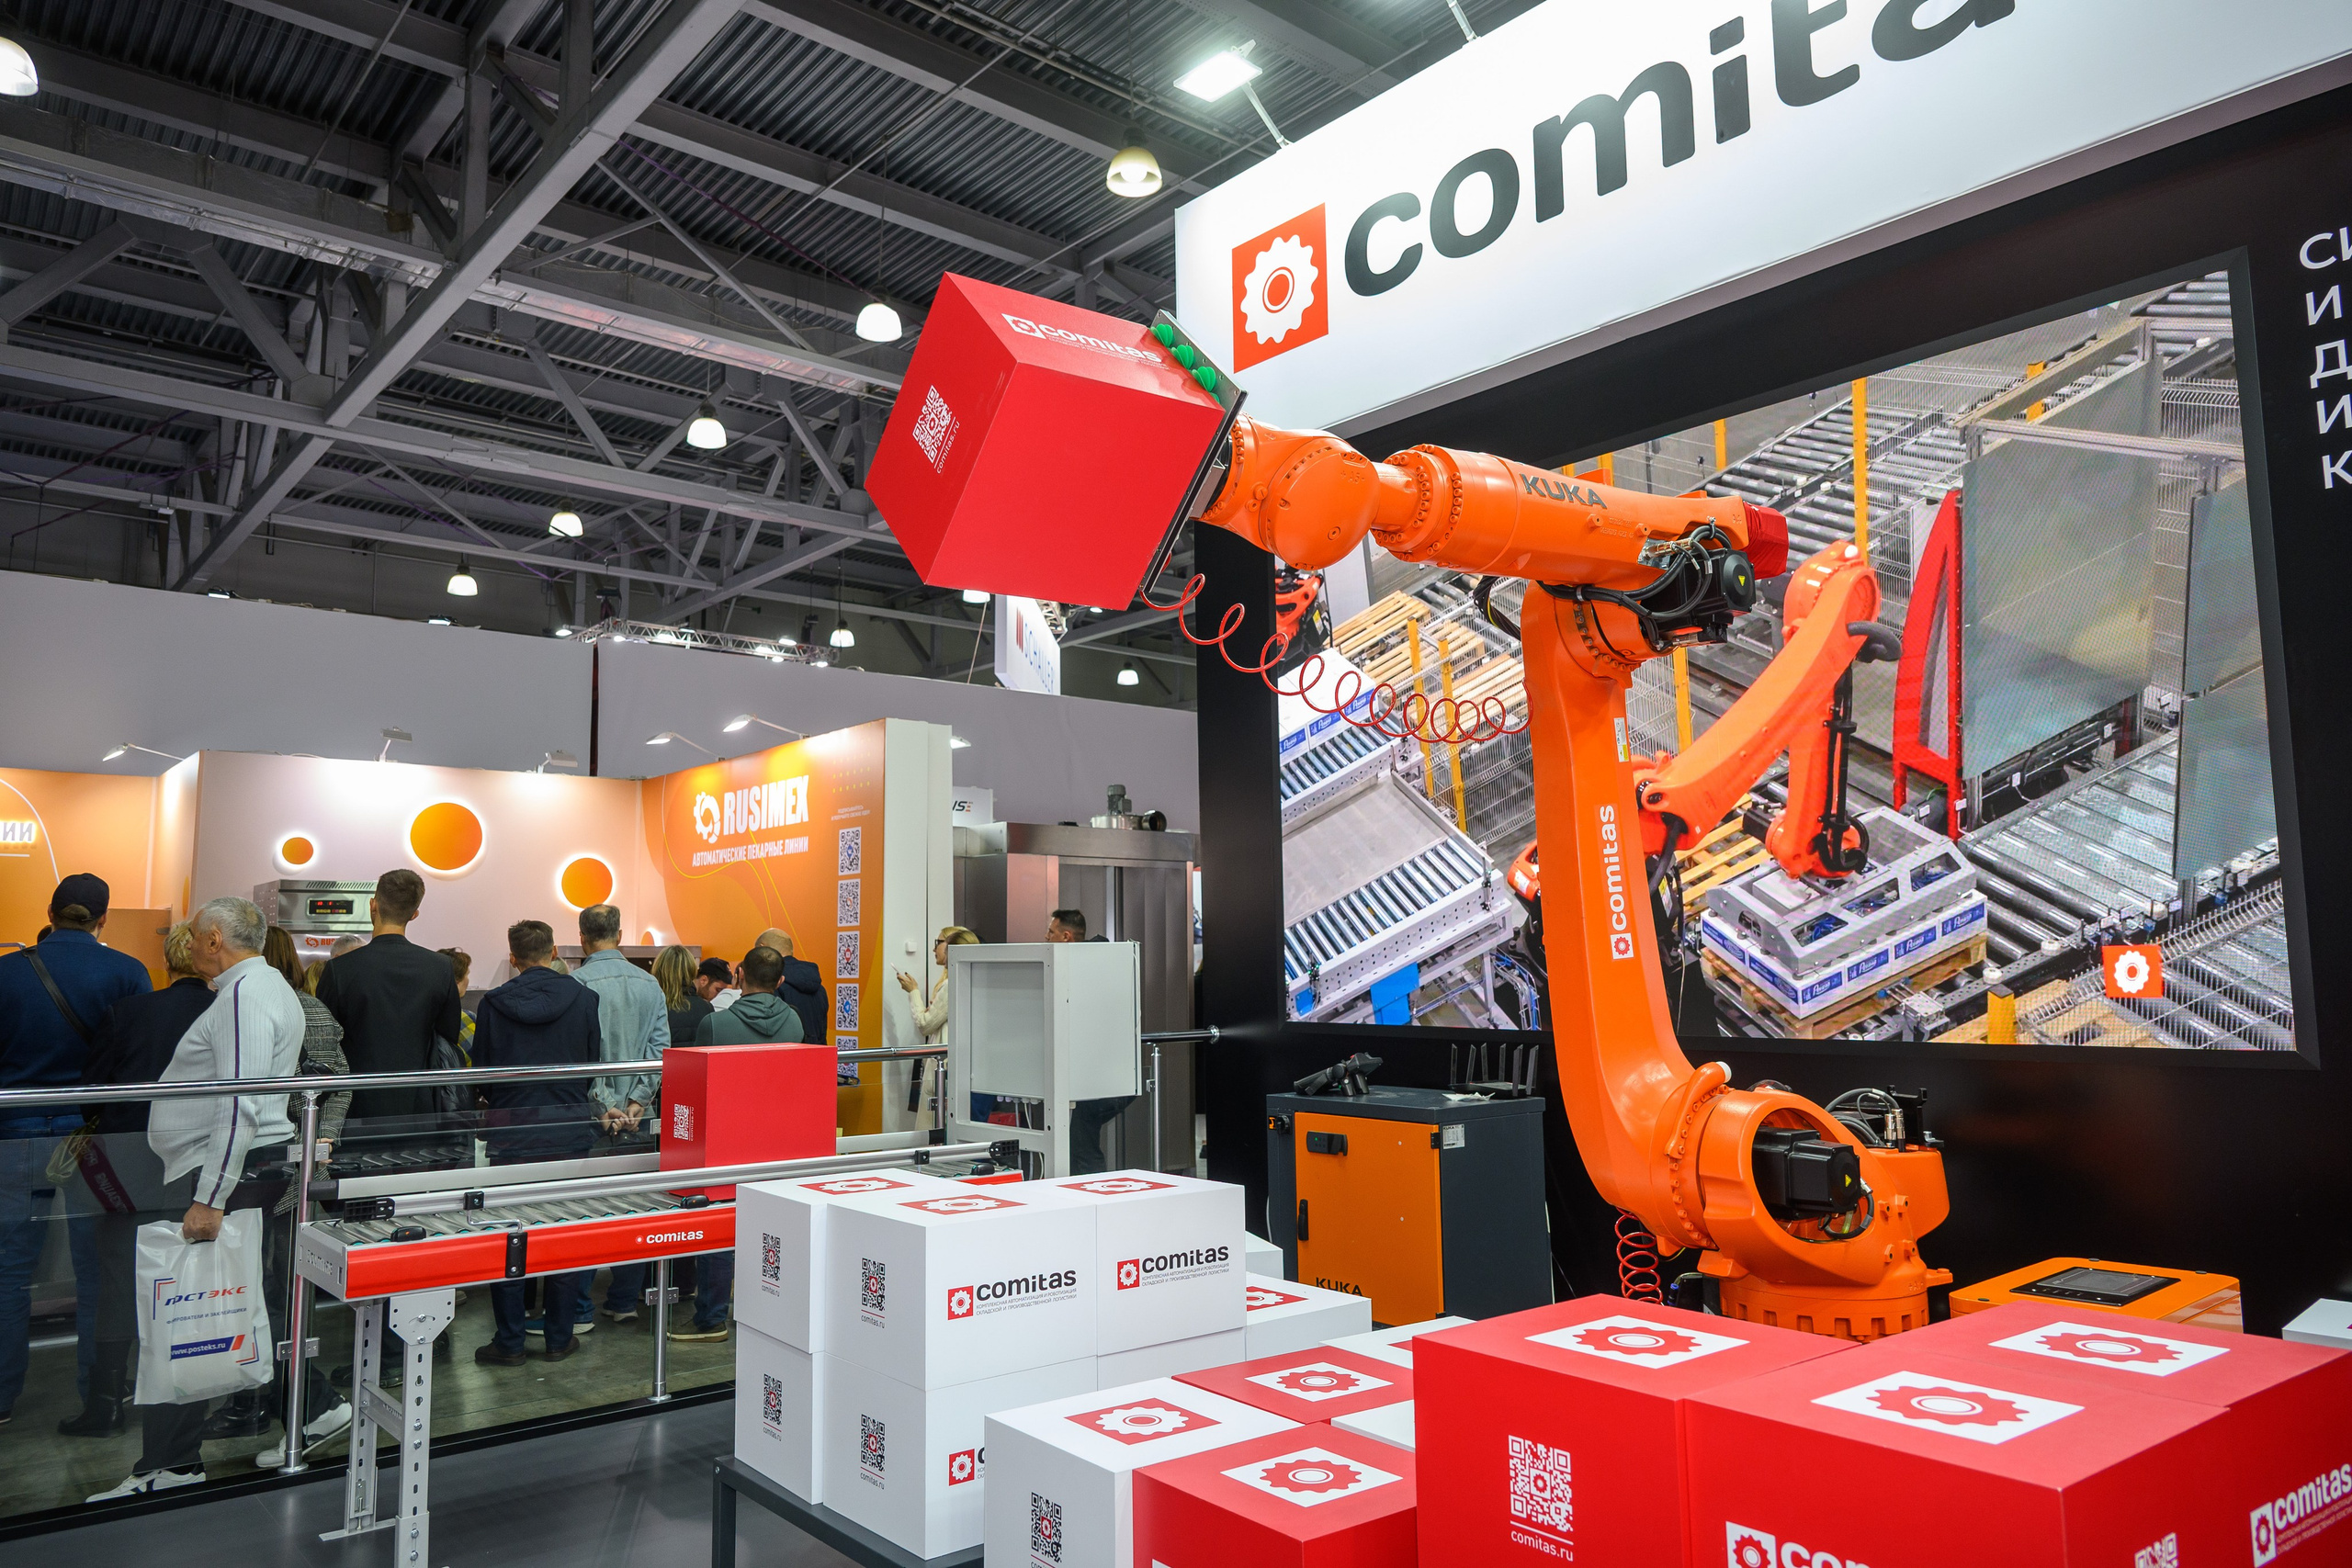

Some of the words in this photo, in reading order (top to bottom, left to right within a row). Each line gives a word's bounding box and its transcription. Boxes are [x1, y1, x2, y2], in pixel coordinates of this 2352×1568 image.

[2305, 284, 2343, 326] И
[1038, 323, 1162, 363] comitas
[935, 420, 961, 474] comitas.ru
[1519, 473, 1608, 510] KUKA
[723, 774, 809, 836] RUSIMEX
[2, 821, 33, 842] ИИ
[692, 846, 747, 867] АВТОМАТИЧЕСКИЕ
[747, 840, 784, 861] ПЕКАРНЫЕ
[784, 836, 808, 854] ЛИНИИ
[1600, 805, 1627, 931] comitas
[646, 1230, 704, 1244] comitas
[1142, 1246, 1229, 1273] comitas
[761, 1284, 780, 1297] comitas.ru
[976, 1269, 1077, 1301] comitas
[1316, 1277, 1363, 1296] KUKA
[860, 1314, 886, 1329] comitas.ru
[763, 1427, 782, 1442] comitas.ru
[860, 1472, 885, 1490] comitas.ru
[2274, 1462, 2352, 1530] comitas
[1510, 1529, 1574, 1562] comitas.ru
